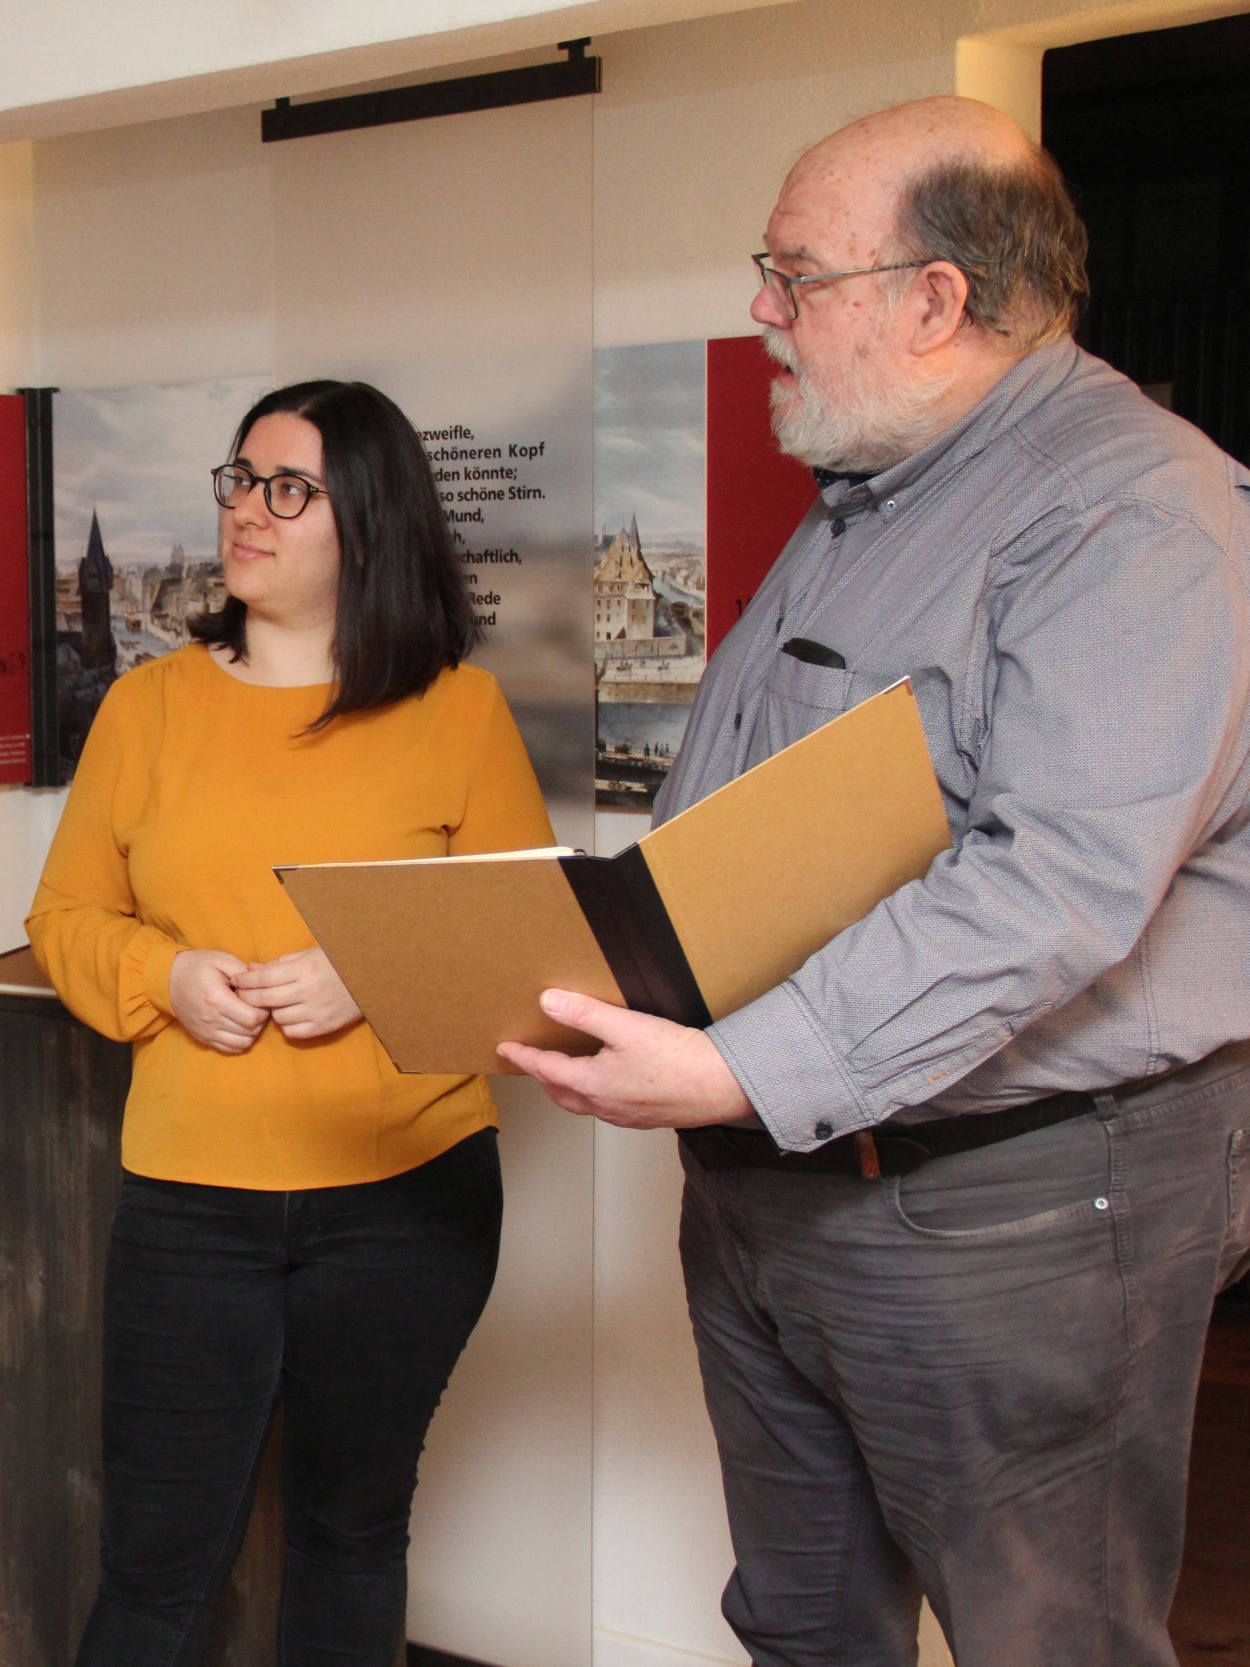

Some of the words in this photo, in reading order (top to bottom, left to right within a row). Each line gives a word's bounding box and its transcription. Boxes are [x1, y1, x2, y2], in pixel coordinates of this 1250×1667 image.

[427, 446, 501, 462] schöneren
[508, 442, 545, 460] Kopf
[435, 468, 460, 482] den
[464, 466, 517, 481] könnte;
[440, 492, 454, 502] so
[457, 487, 505, 502] schöne
[508, 485, 546, 500] Stirn.
